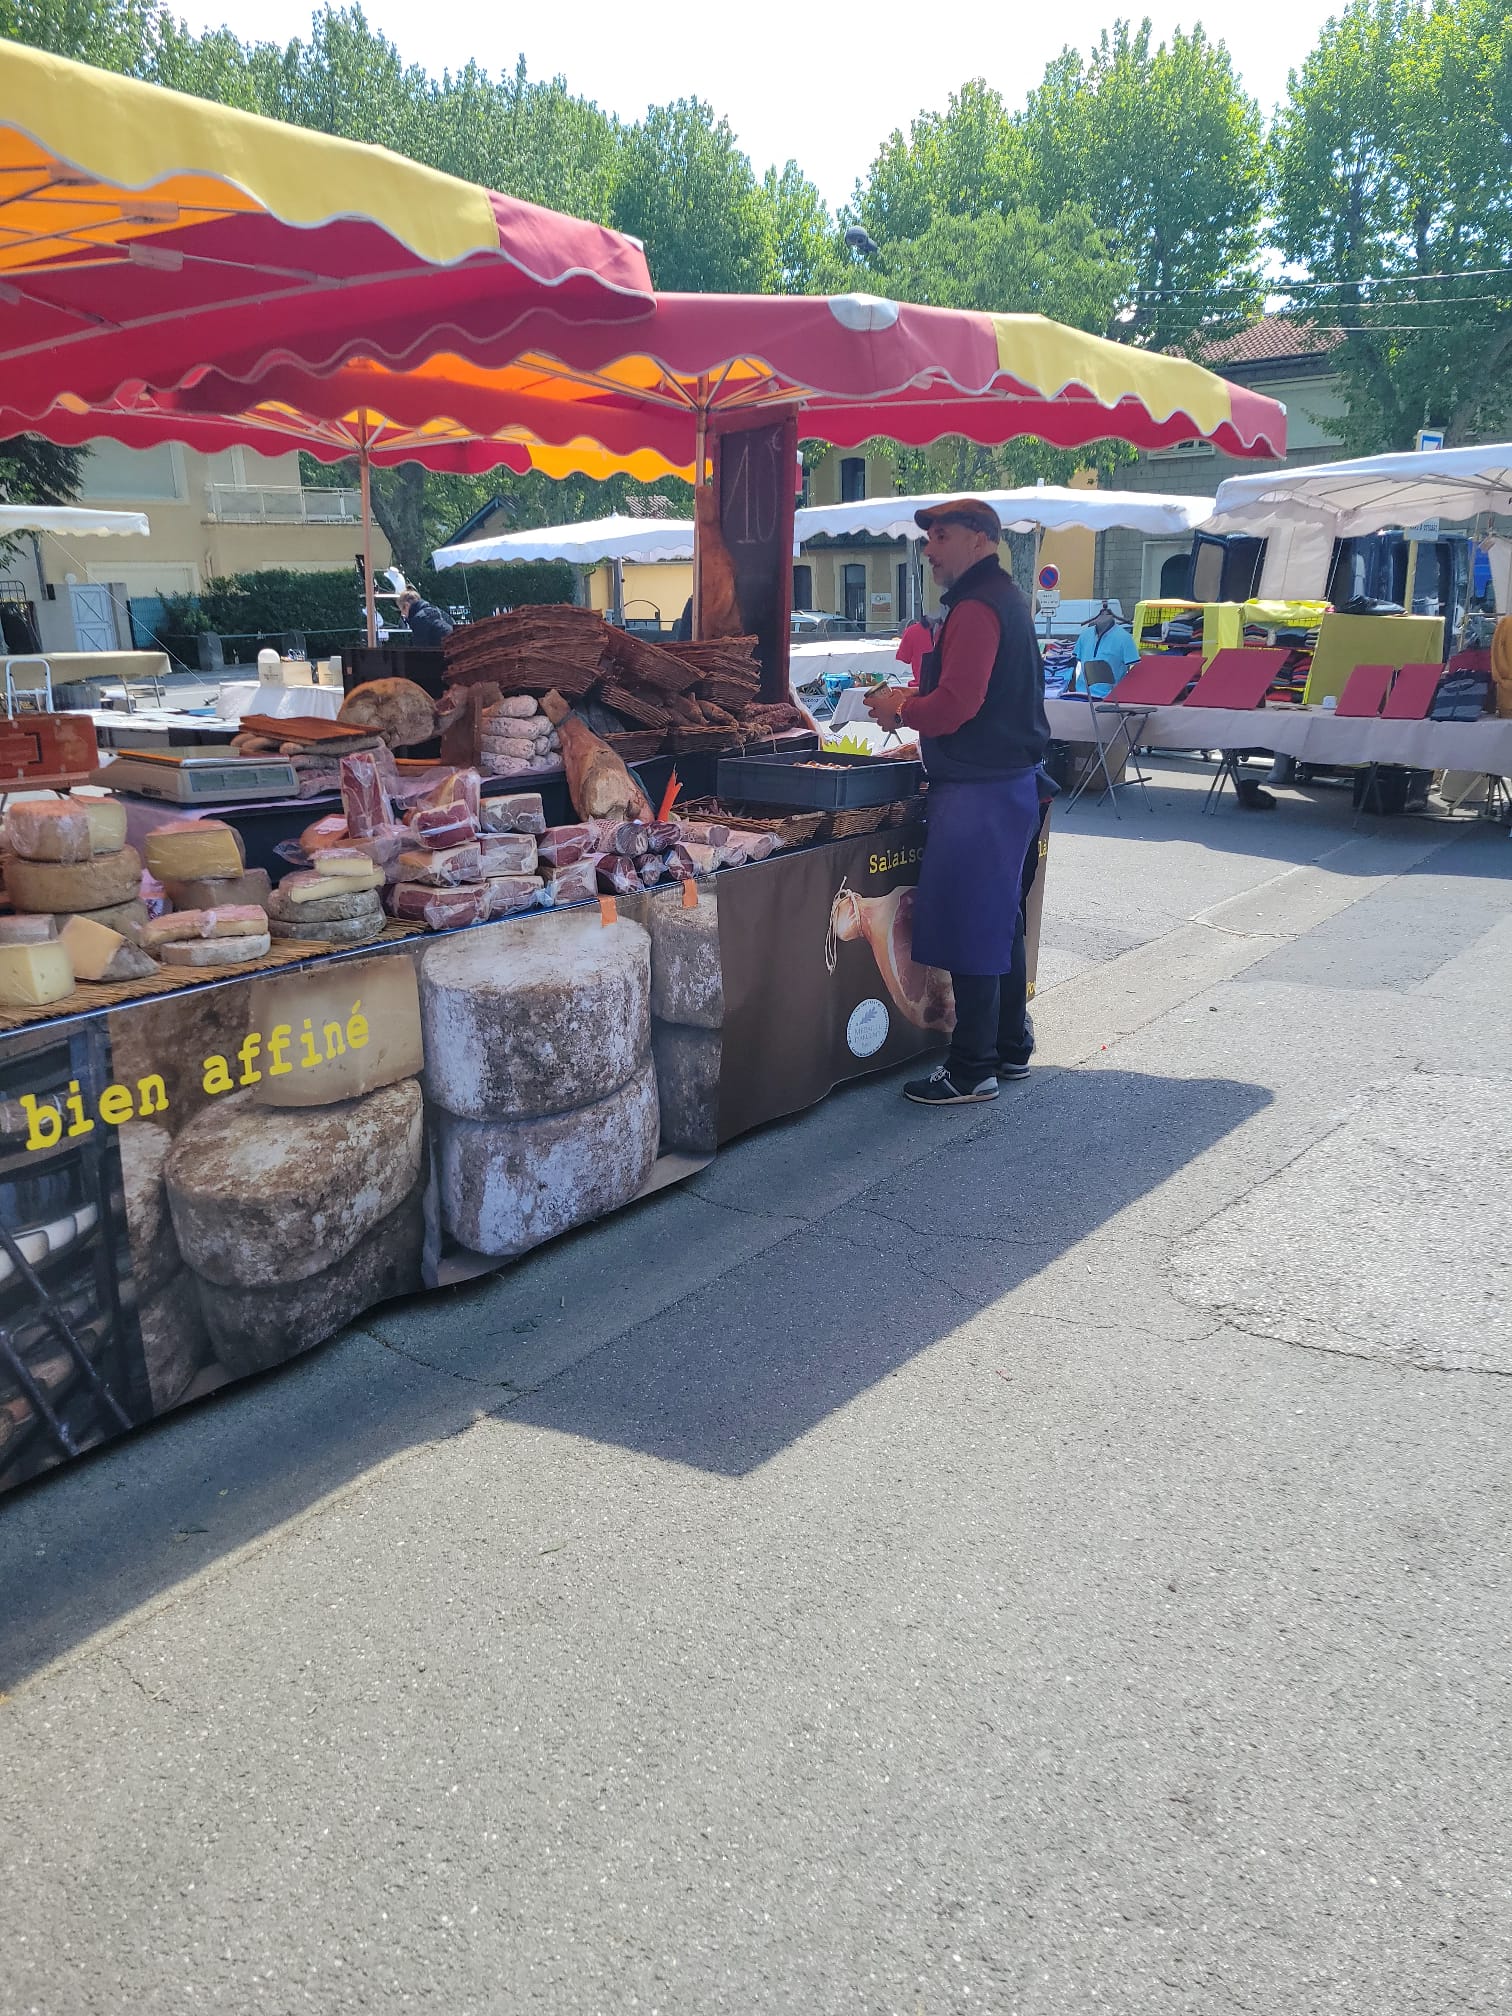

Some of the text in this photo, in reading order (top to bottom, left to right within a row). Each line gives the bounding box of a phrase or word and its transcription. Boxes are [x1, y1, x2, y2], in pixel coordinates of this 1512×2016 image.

[869, 845, 924, 874] Salaiso
[20, 1000, 369, 1151] bien affiné
